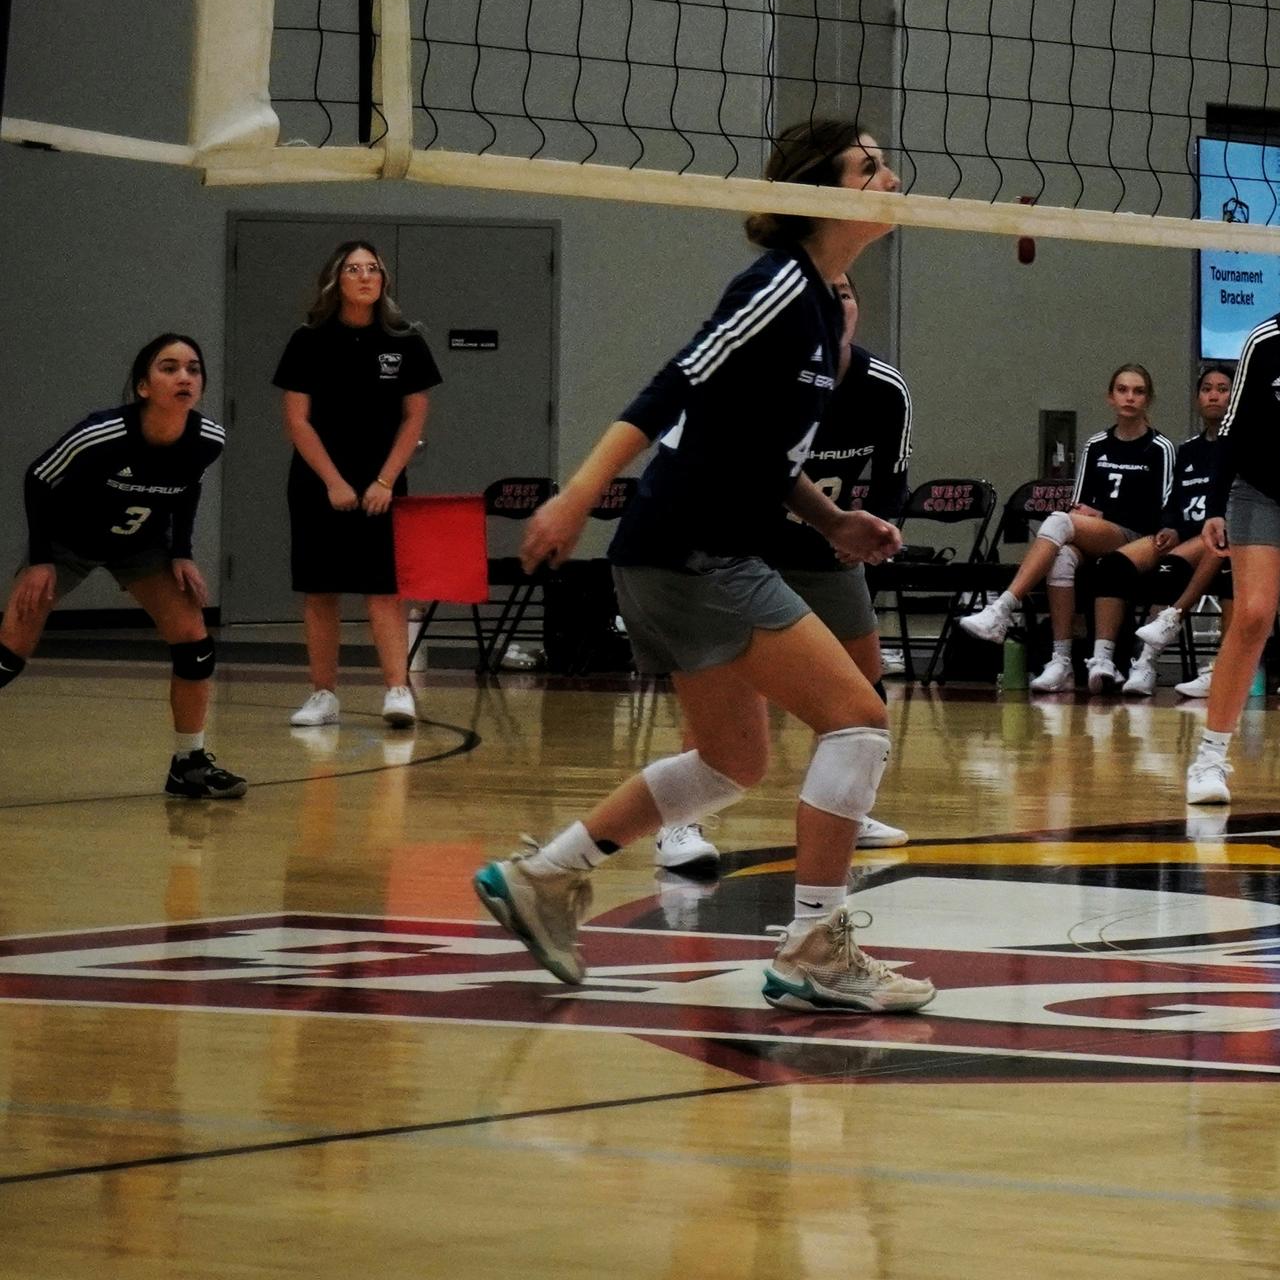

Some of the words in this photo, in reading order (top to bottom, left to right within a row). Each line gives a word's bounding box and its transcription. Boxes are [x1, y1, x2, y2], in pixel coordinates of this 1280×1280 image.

[1210, 265, 1264, 284] Tournament
[1220, 290, 1255, 307] Bracket
[786, 421, 820, 478] 4
[930, 484, 974, 499] WEST
[1032, 484, 1074, 499] WEST
[1107, 472, 1123, 499] 7
[922, 496, 975, 512] COAST
[110, 506, 152, 535] 3
